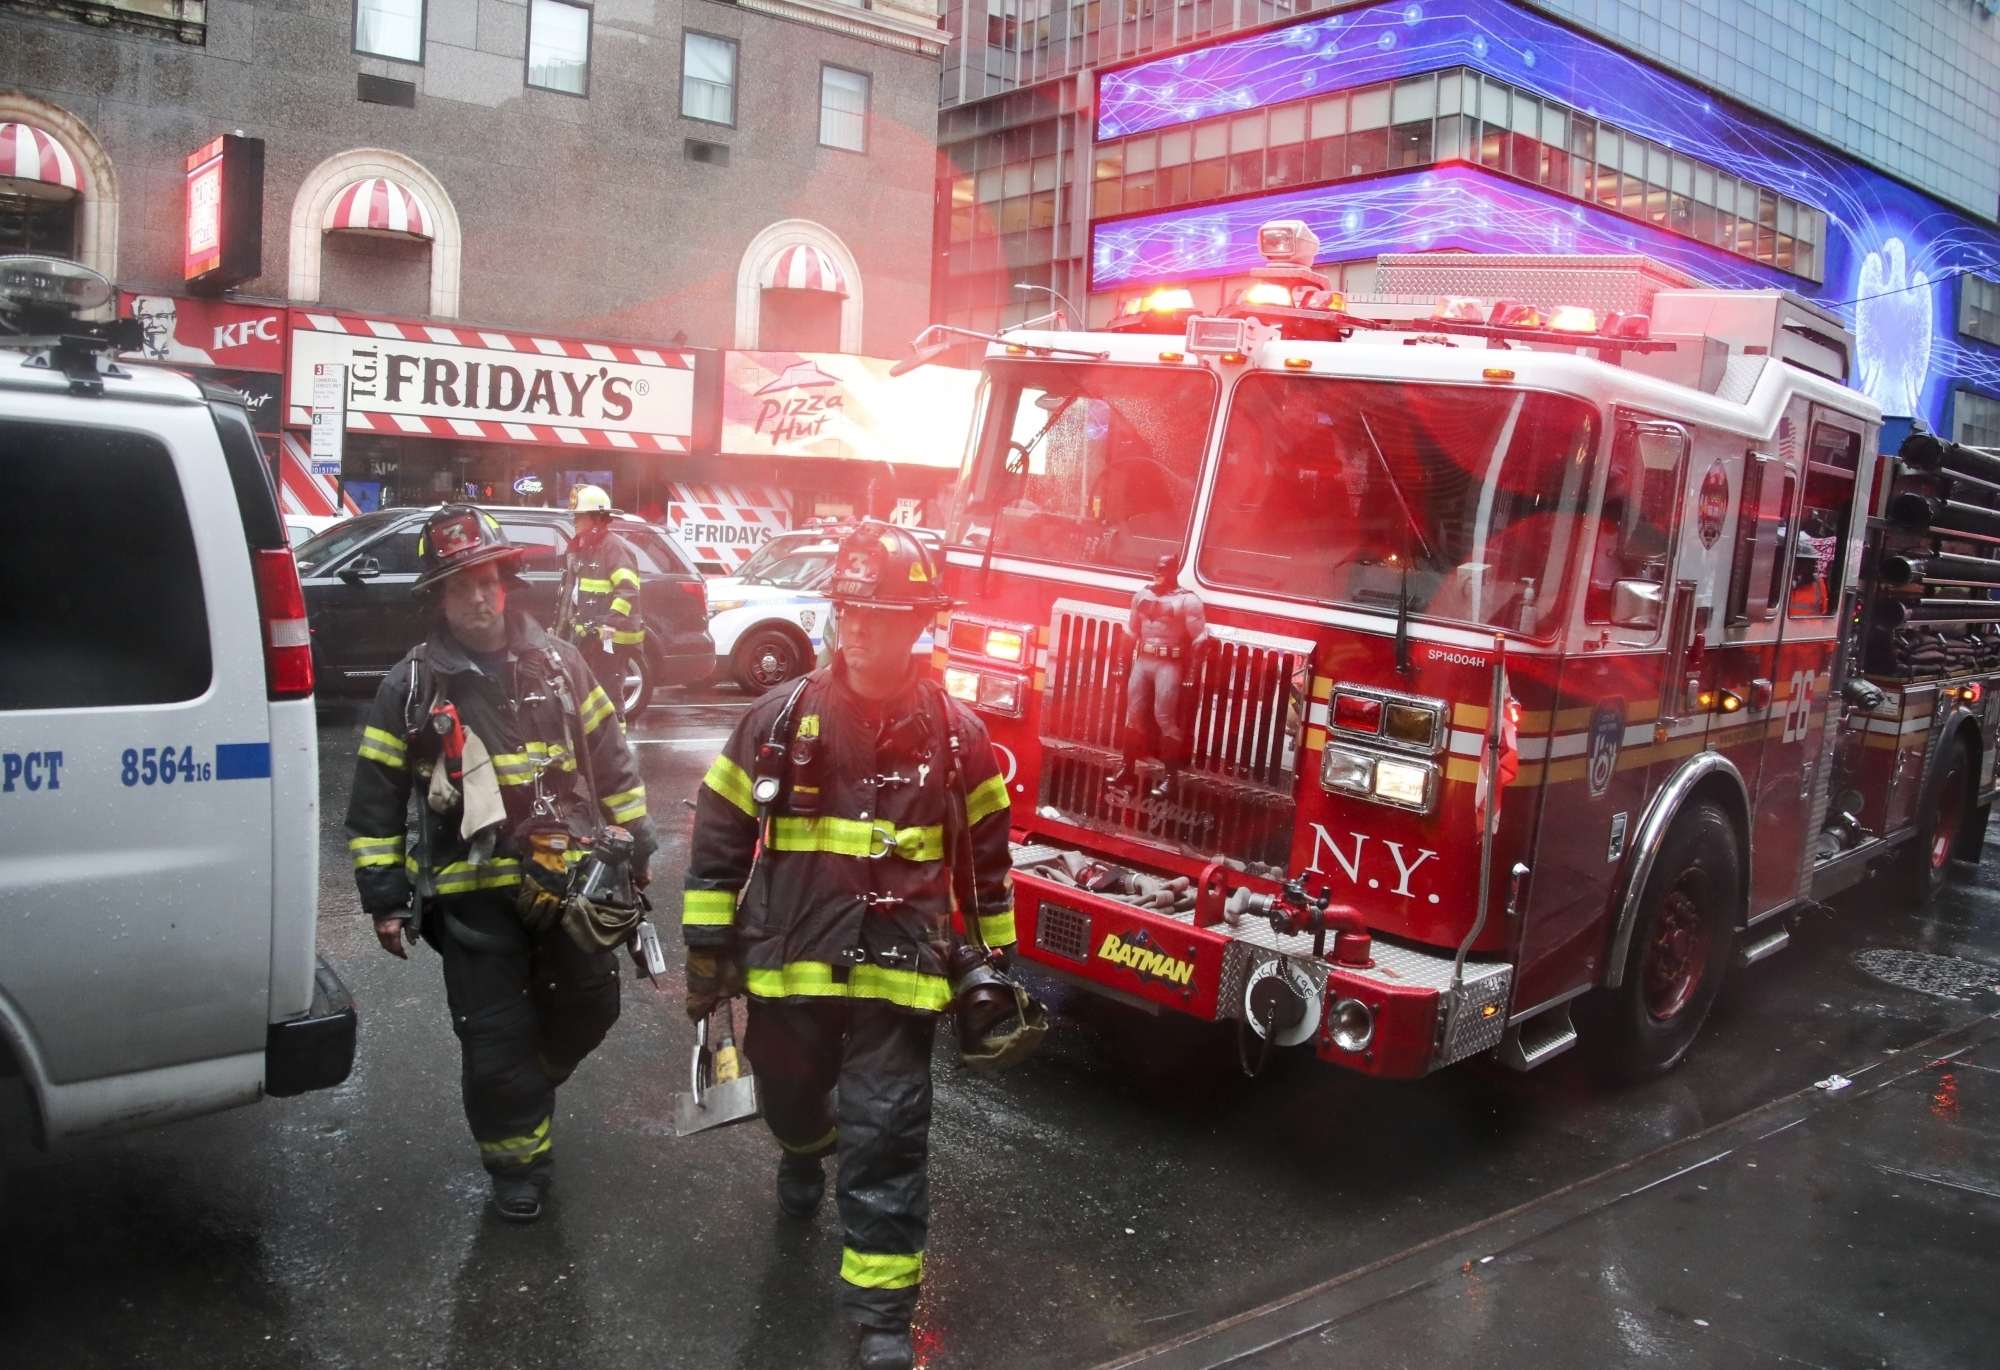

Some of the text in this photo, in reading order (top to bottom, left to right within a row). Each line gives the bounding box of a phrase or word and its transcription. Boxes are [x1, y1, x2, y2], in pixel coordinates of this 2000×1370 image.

[213, 316, 278, 350] KFC
[384, 353, 634, 421] FRIDAY'S
[755, 394, 844, 434] Pizza
[770, 414, 832, 446] Hut
[443, 523, 468, 552] 3
[684, 522, 772, 545] TGI FRIDAYS
[845, 551, 870, 578] 3
[1427, 648, 1487, 668] SP14004H
[1782, 669, 1816, 744] 26
[2, 751, 63, 792] PCT
[1304, 821, 1441, 904] N.Y.
[1098, 933, 1195, 985] BATMAN
